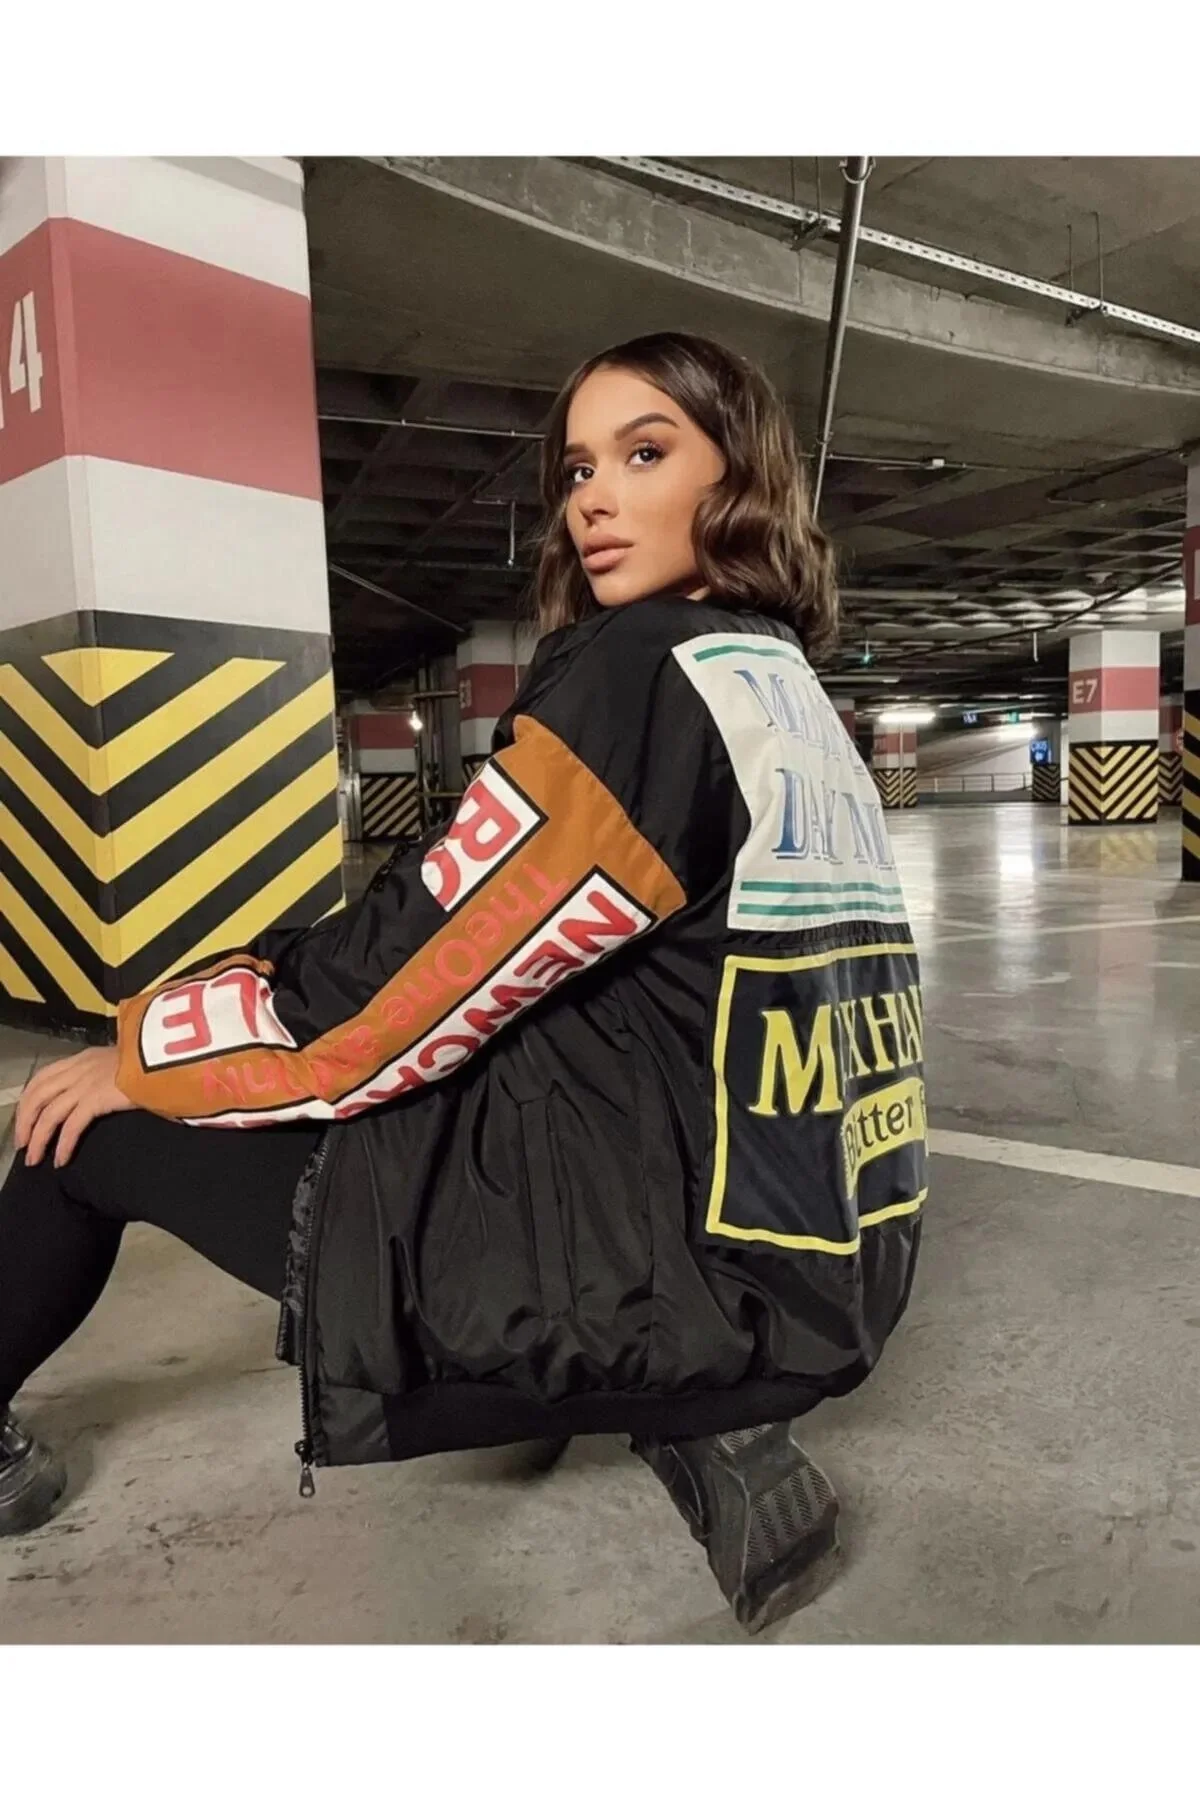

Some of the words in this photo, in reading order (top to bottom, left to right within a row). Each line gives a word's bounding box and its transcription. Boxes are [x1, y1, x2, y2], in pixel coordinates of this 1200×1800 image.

[0, 290, 43, 430] 4
[1072, 678, 1098, 704] E7
[771, 767, 844, 865] DAY
[161, 972, 272, 1055] LE
[748, 984, 925, 1116] MXHA
